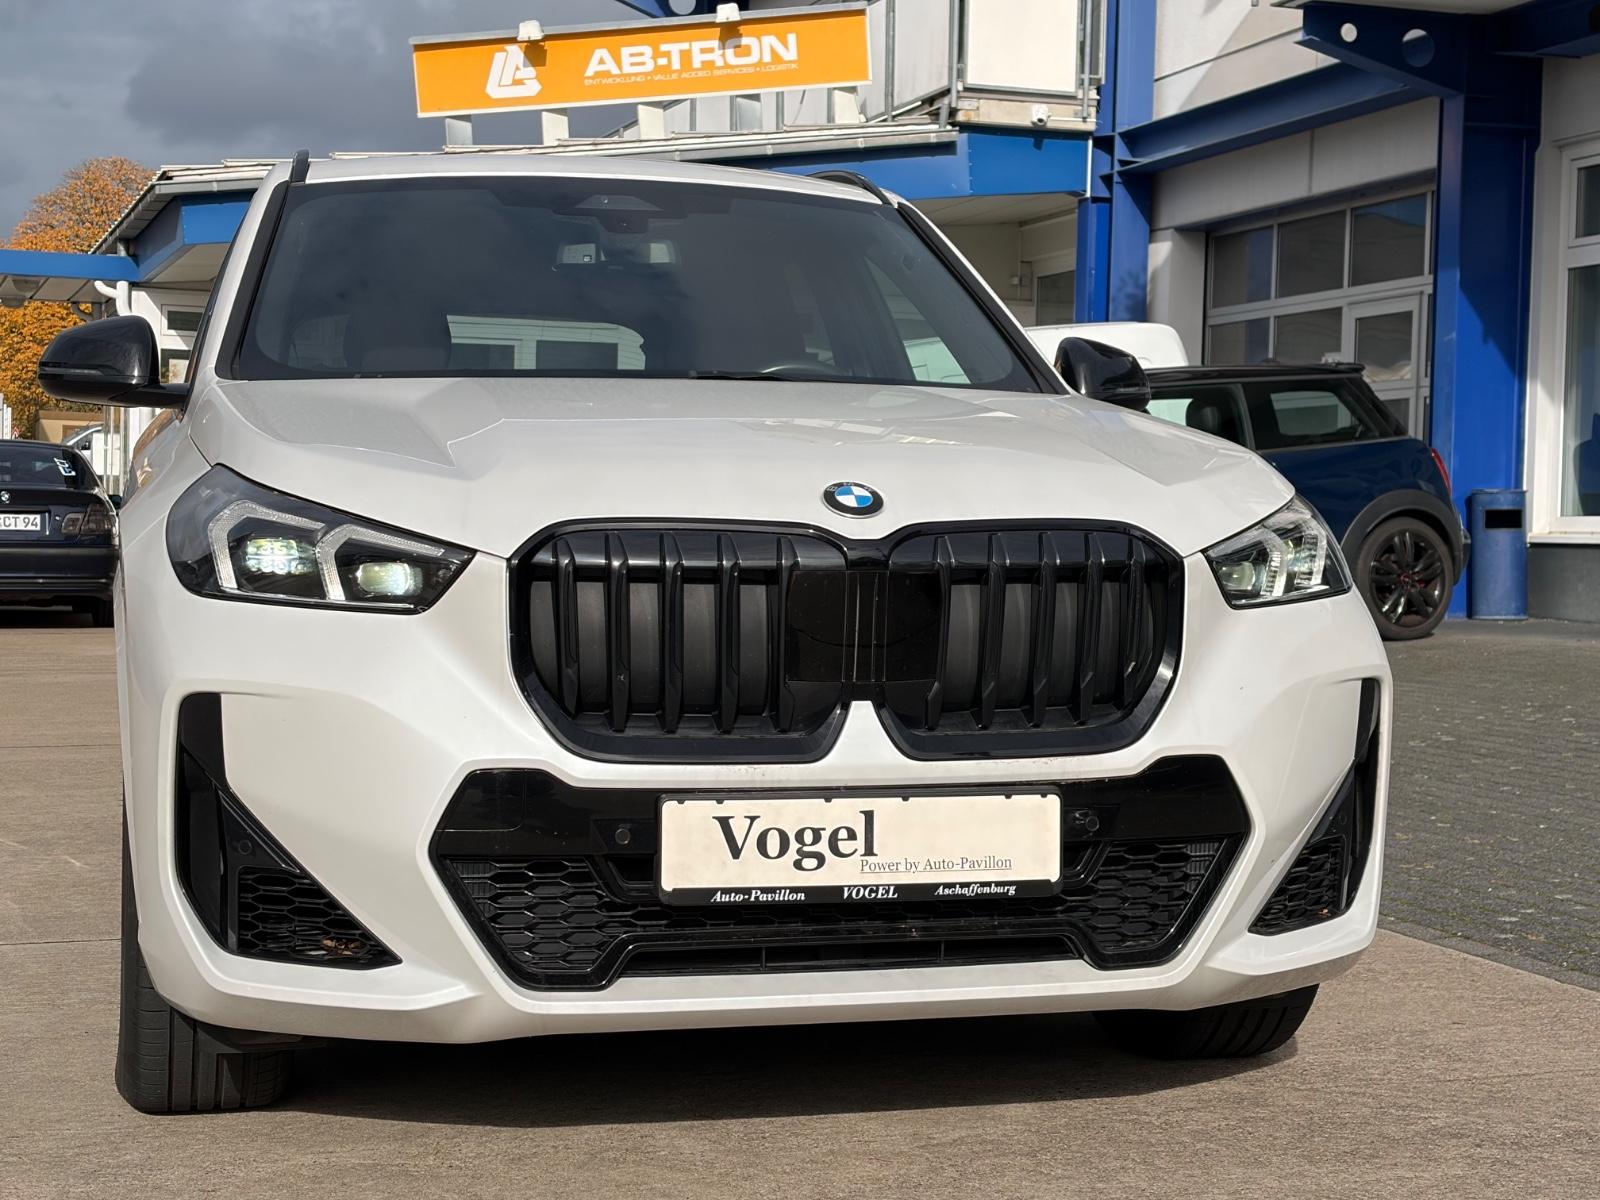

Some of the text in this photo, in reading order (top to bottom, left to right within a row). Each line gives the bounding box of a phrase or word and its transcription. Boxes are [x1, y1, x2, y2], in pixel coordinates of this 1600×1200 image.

[584, 33, 799, 77] AB-TRON
[653, 73, 679, 81] VALUE
[713, 67, 755, 77] SERVICES
[22, 516, 38, 528] 94
[712, 810, 878, 872] Vogel
[860, 856, 1013, 874] Power by Auto-Pavillon
[710, 883, 1017, 903] Auto-Pavillon VOGEL Aschaffenburg
